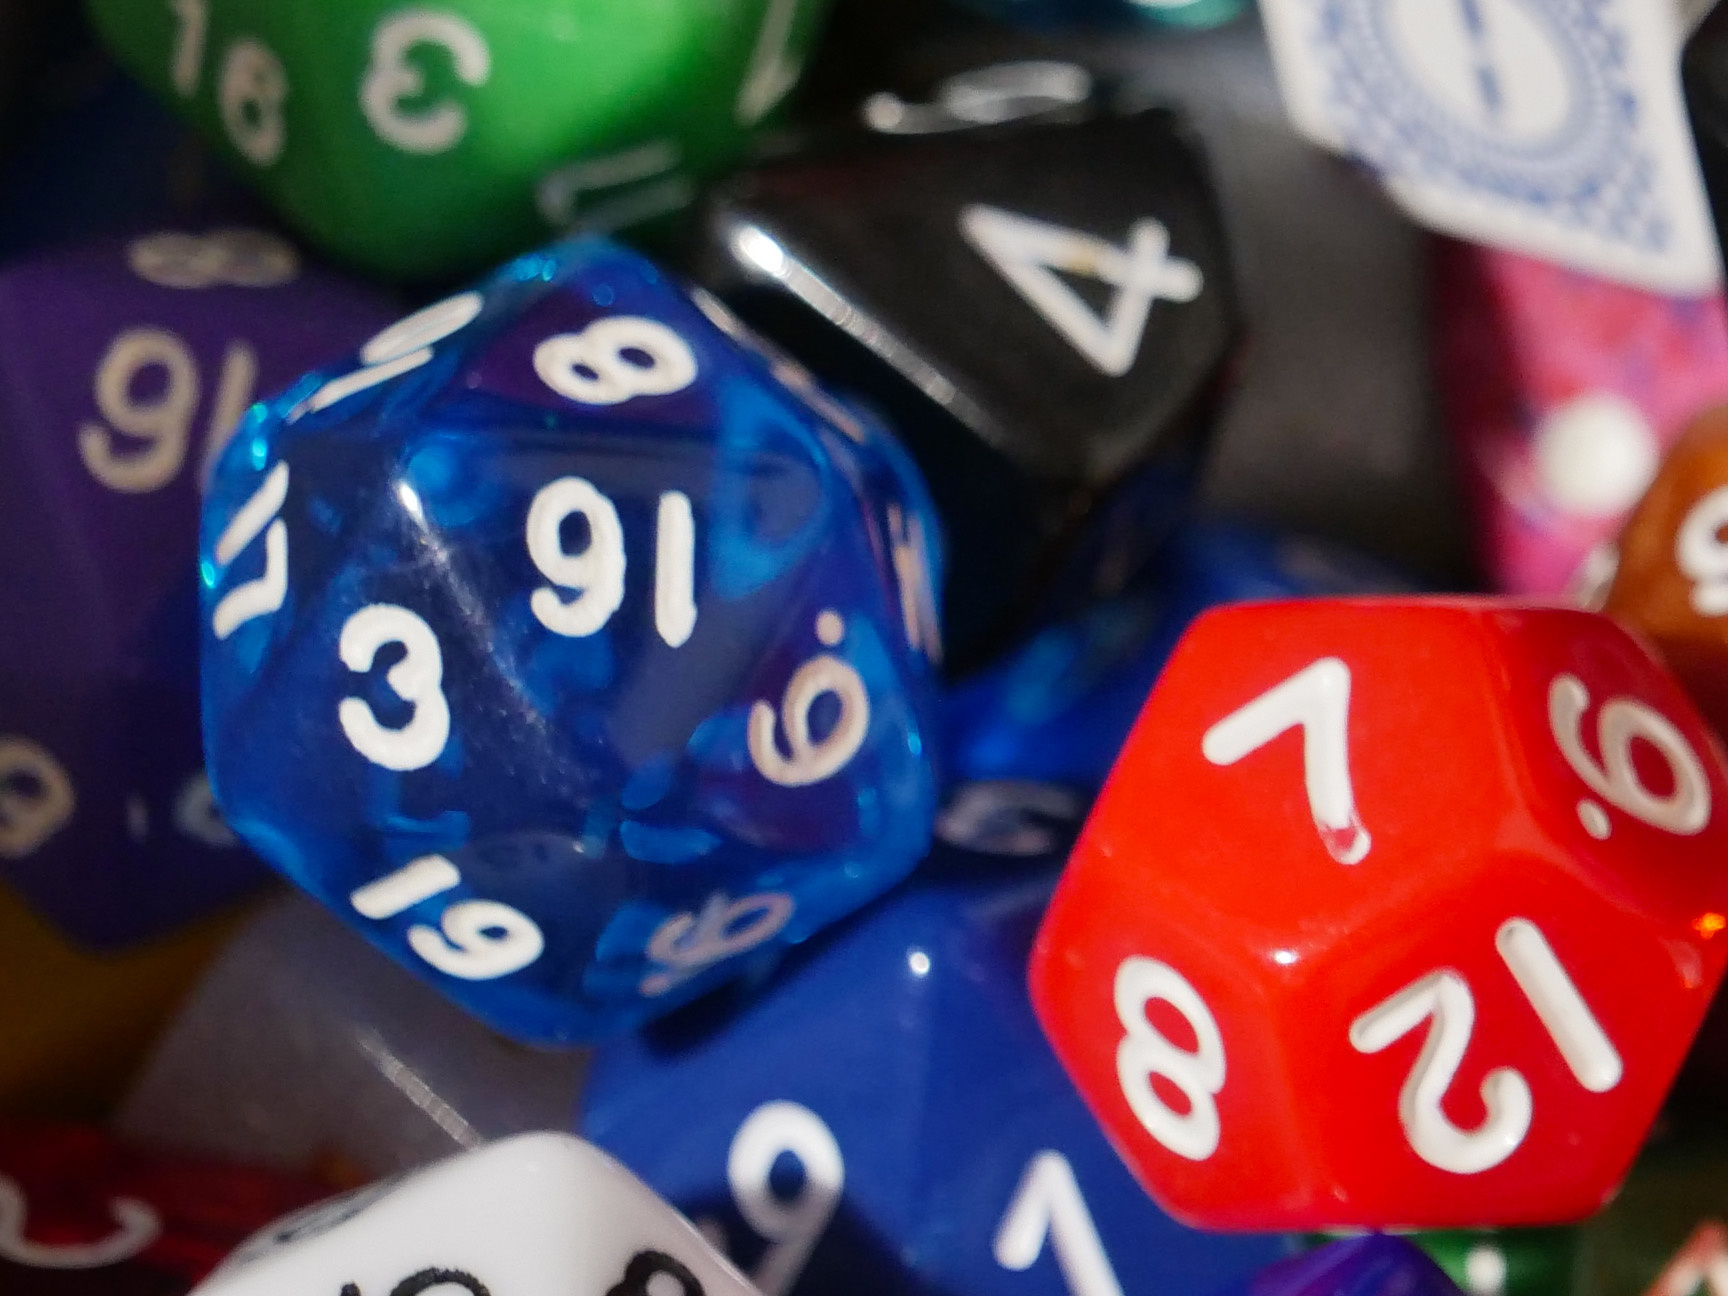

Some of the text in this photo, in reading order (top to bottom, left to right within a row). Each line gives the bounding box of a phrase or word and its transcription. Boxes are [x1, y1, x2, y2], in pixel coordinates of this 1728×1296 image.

[358, 4, 493, 156] 3
[532, 314, 698, 406] 8
[956, 202, 1206, 378] 4
[209, 459, 292, 640] 17
[525, 474, 699, 650] 16
[338, 602, 452, 772] 3
[1200, 655, 1373, 867] 7
[349, 852, 547, 982] 19
[1112, 953, 1228, 1162] 8
[1347, 914, 1625, 1176] 12
